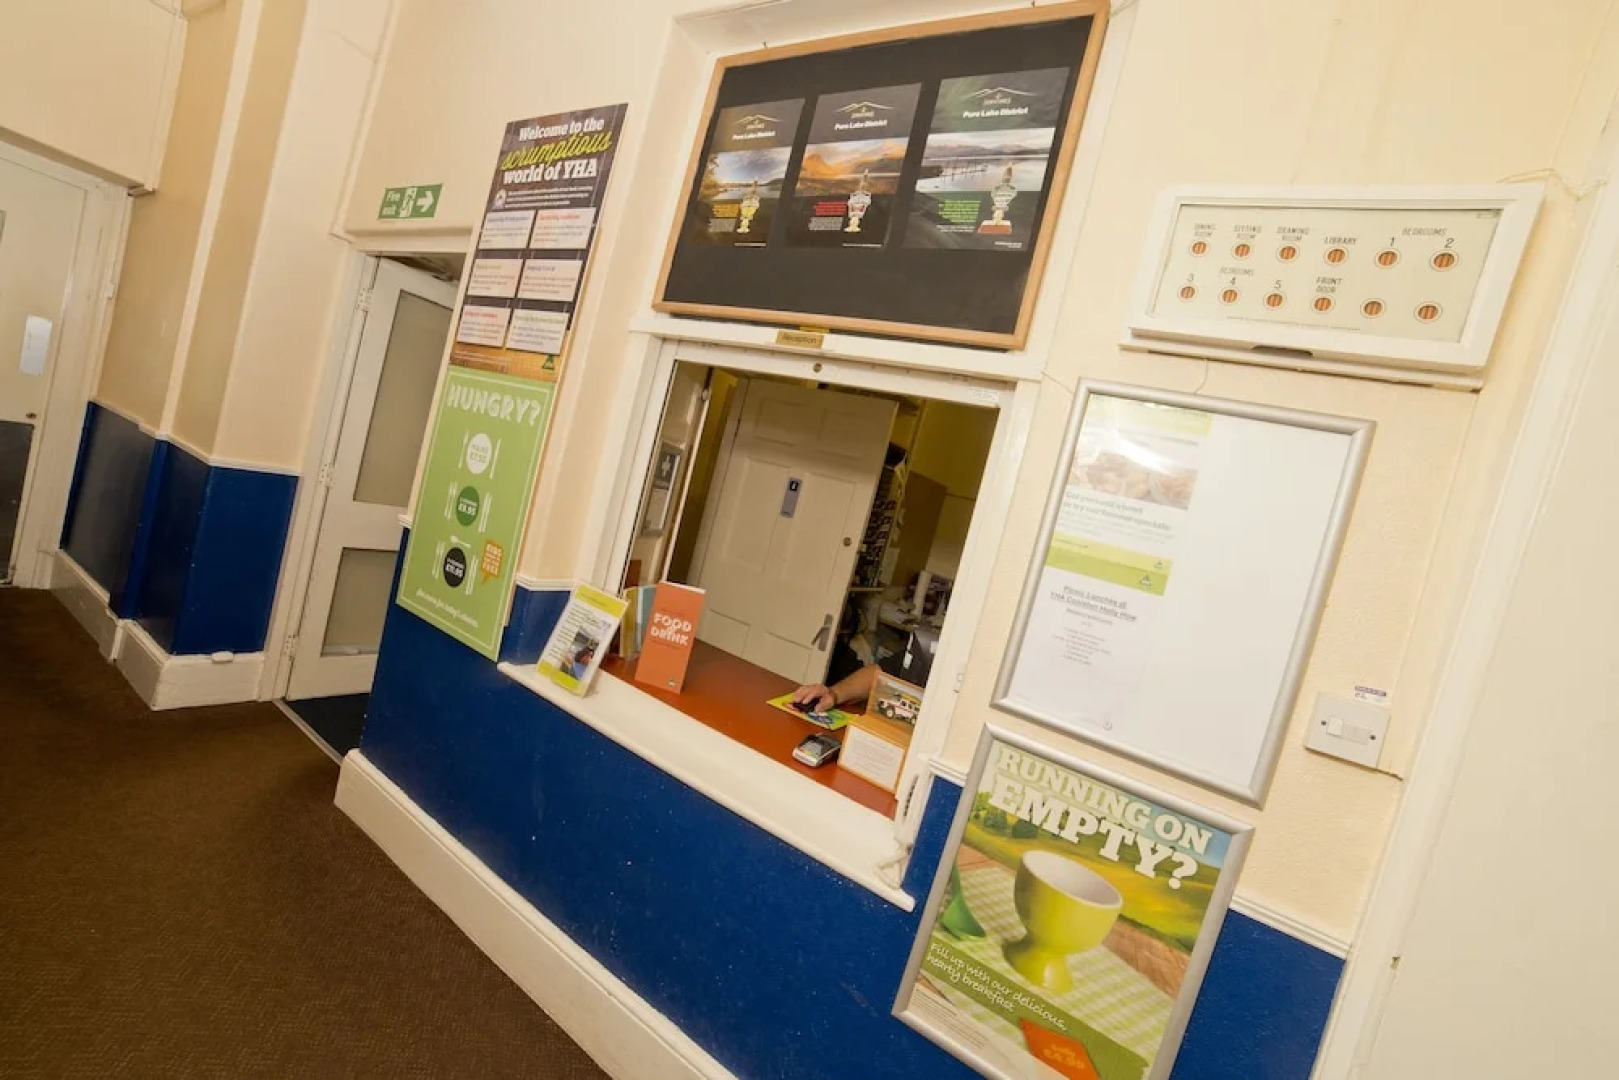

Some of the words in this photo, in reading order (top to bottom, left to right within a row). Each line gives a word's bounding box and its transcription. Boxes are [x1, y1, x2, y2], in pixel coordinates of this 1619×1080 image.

[962, 110, 980, 119] Pure
[980, 109, 1000, 118] Lake
[1000, 106, 1029, 116] District
[519, 124, 569, 142] Welcome
[569, 120, 582, 134] to
[582, 116, 605, 132] the
[834, 122, 850, 131] Pure
[849, 120, 864, 129] Lake
[864, 118, 888, 128] District
[503, 163, 545, 186] world
[543, 161, 563, 181] of
[562, 158, 598, 180] YHA
[1276, 226, 1311, 235] DRAWING
[1401, 226, 1447, 237] BEDROOMS
[1323, 235, 1359, 246] LIBRARY
[1389, 237, 1396, 247] 1
[1443, 237, 1456, 250] 2
[1186, 273, 1195, 283] 3
[1229, 276, 1237, 286] 4
[1315, 276, 1343, 287] FRONT
[1273, 279, 1283, 291] 5
[446, 382, 541, 427] HUNGRY?
[653, 612, 693, 633] FOOD
[650, 626, 690, 647] DRINK
[999, 746, 1153, 831] RUNNING
[1153, 813, 1214, 856] ON
[988, 773, 1200, 891] EMPTY?
[926, 951, 961, 984] hearty
[961, 973, 1016, 1014] breakfast
[930, 942, 950, 960] Fill
[950, 956, 966, 969] up
[966, 963, 991, 985] with
[990, 979, 1014, 995] our
[1012, 992, 1069, 1032] delicious,
